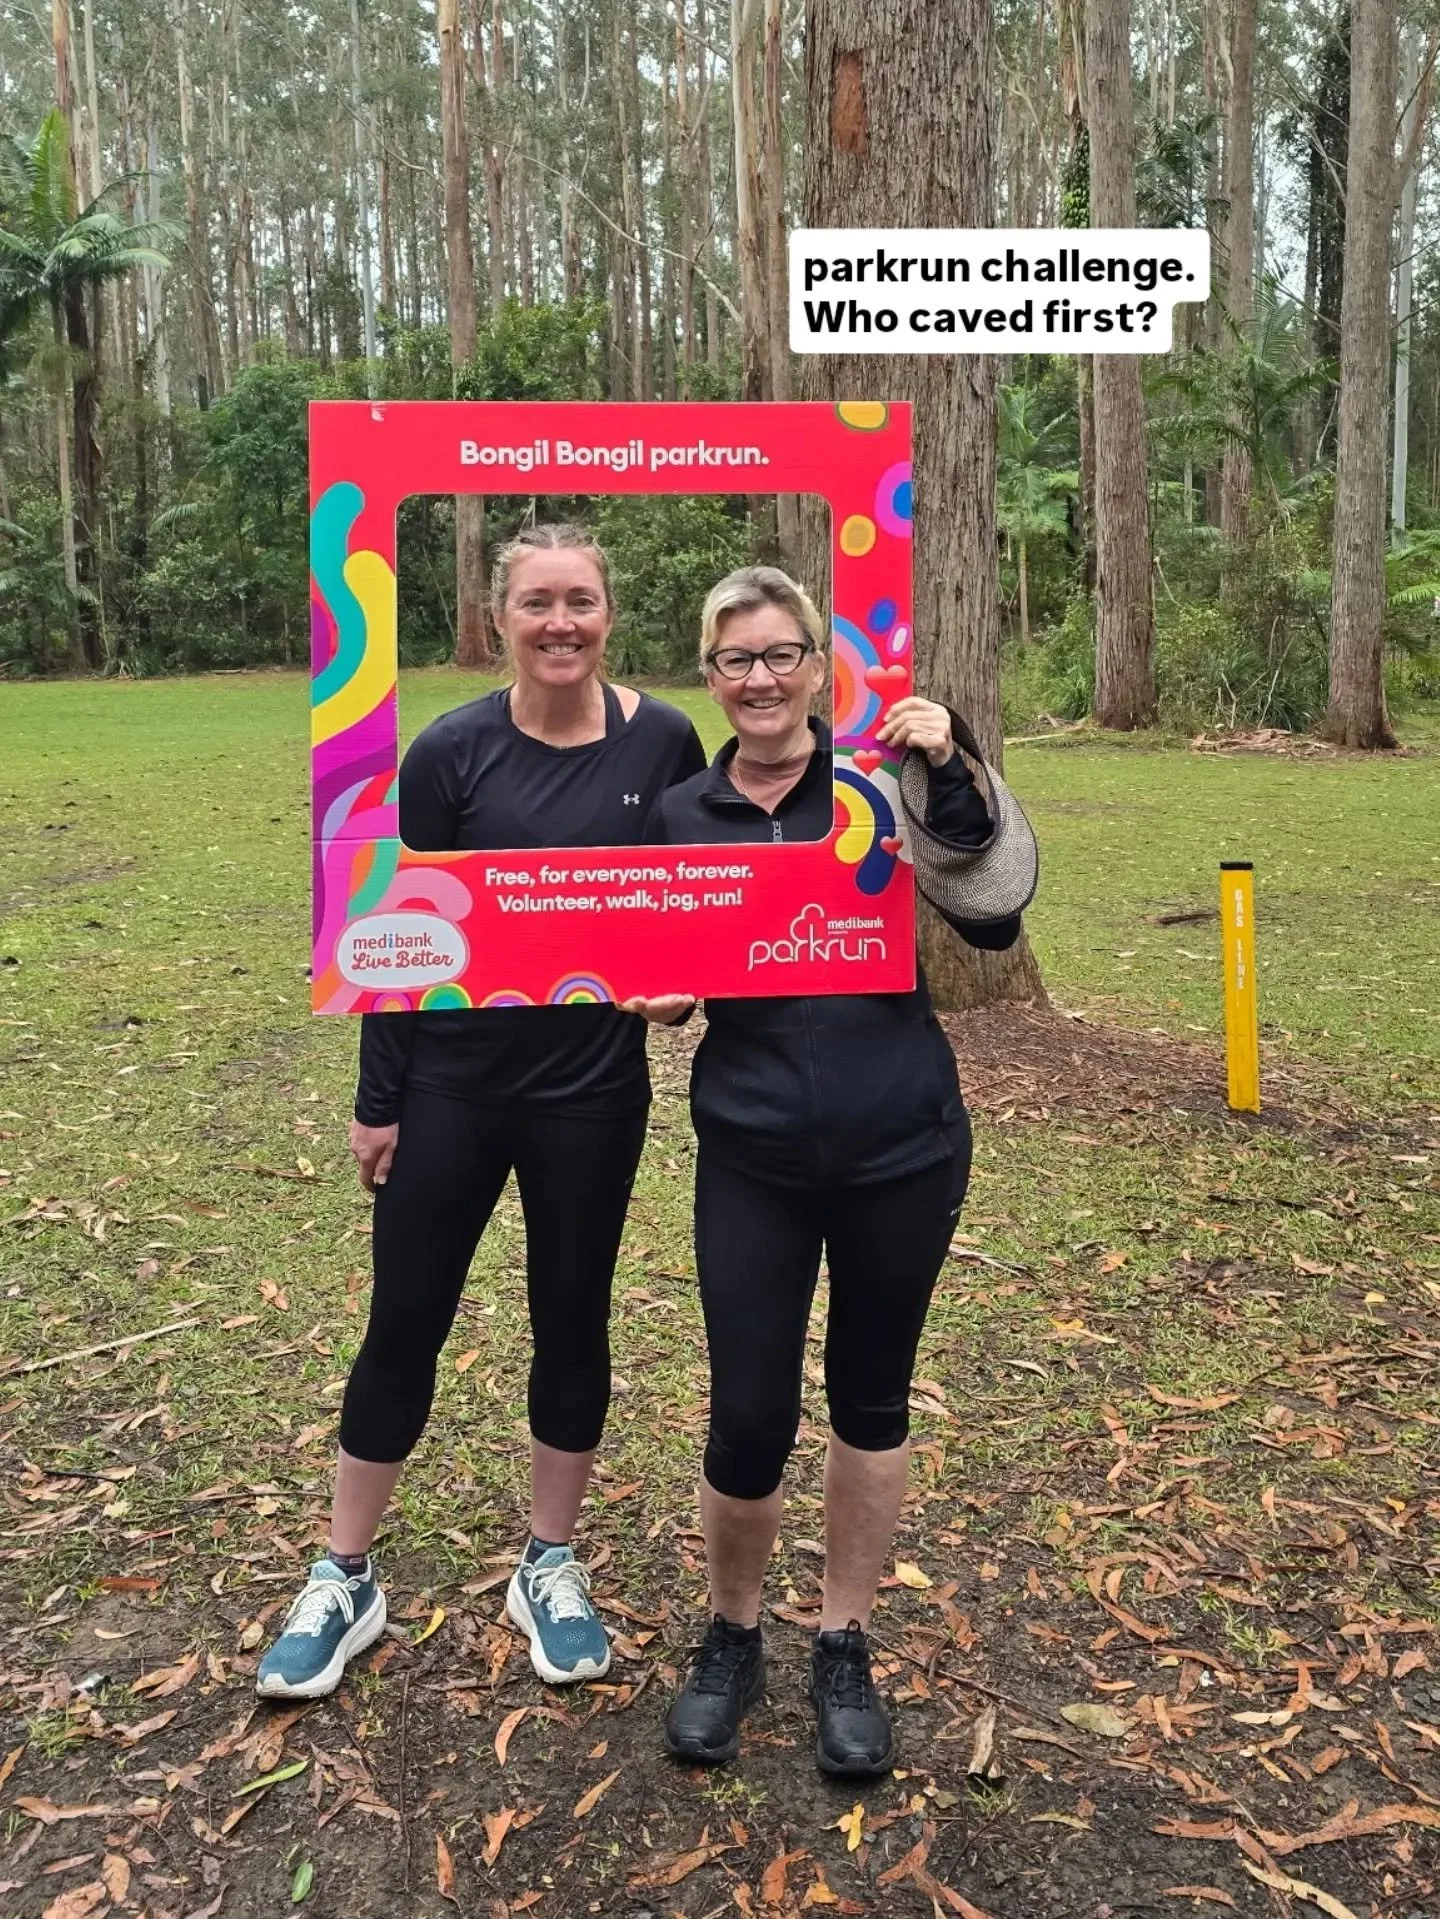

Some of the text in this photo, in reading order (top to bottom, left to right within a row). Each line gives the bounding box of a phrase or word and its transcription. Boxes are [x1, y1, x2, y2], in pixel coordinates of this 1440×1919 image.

[460, 440, 770, 472] Bongil Bongil parkrun.
[485, 861, 754, 887] Free, for everyone, forever.
[497, 888, 743, 913] Volunteer, walk, jog, run!
[827, 916, 885, 930] medibank
[352, 932, 433, 950] medibank
[747, 922, 887, 972] parkrun
[351, 950, 454, 970] Live Better
